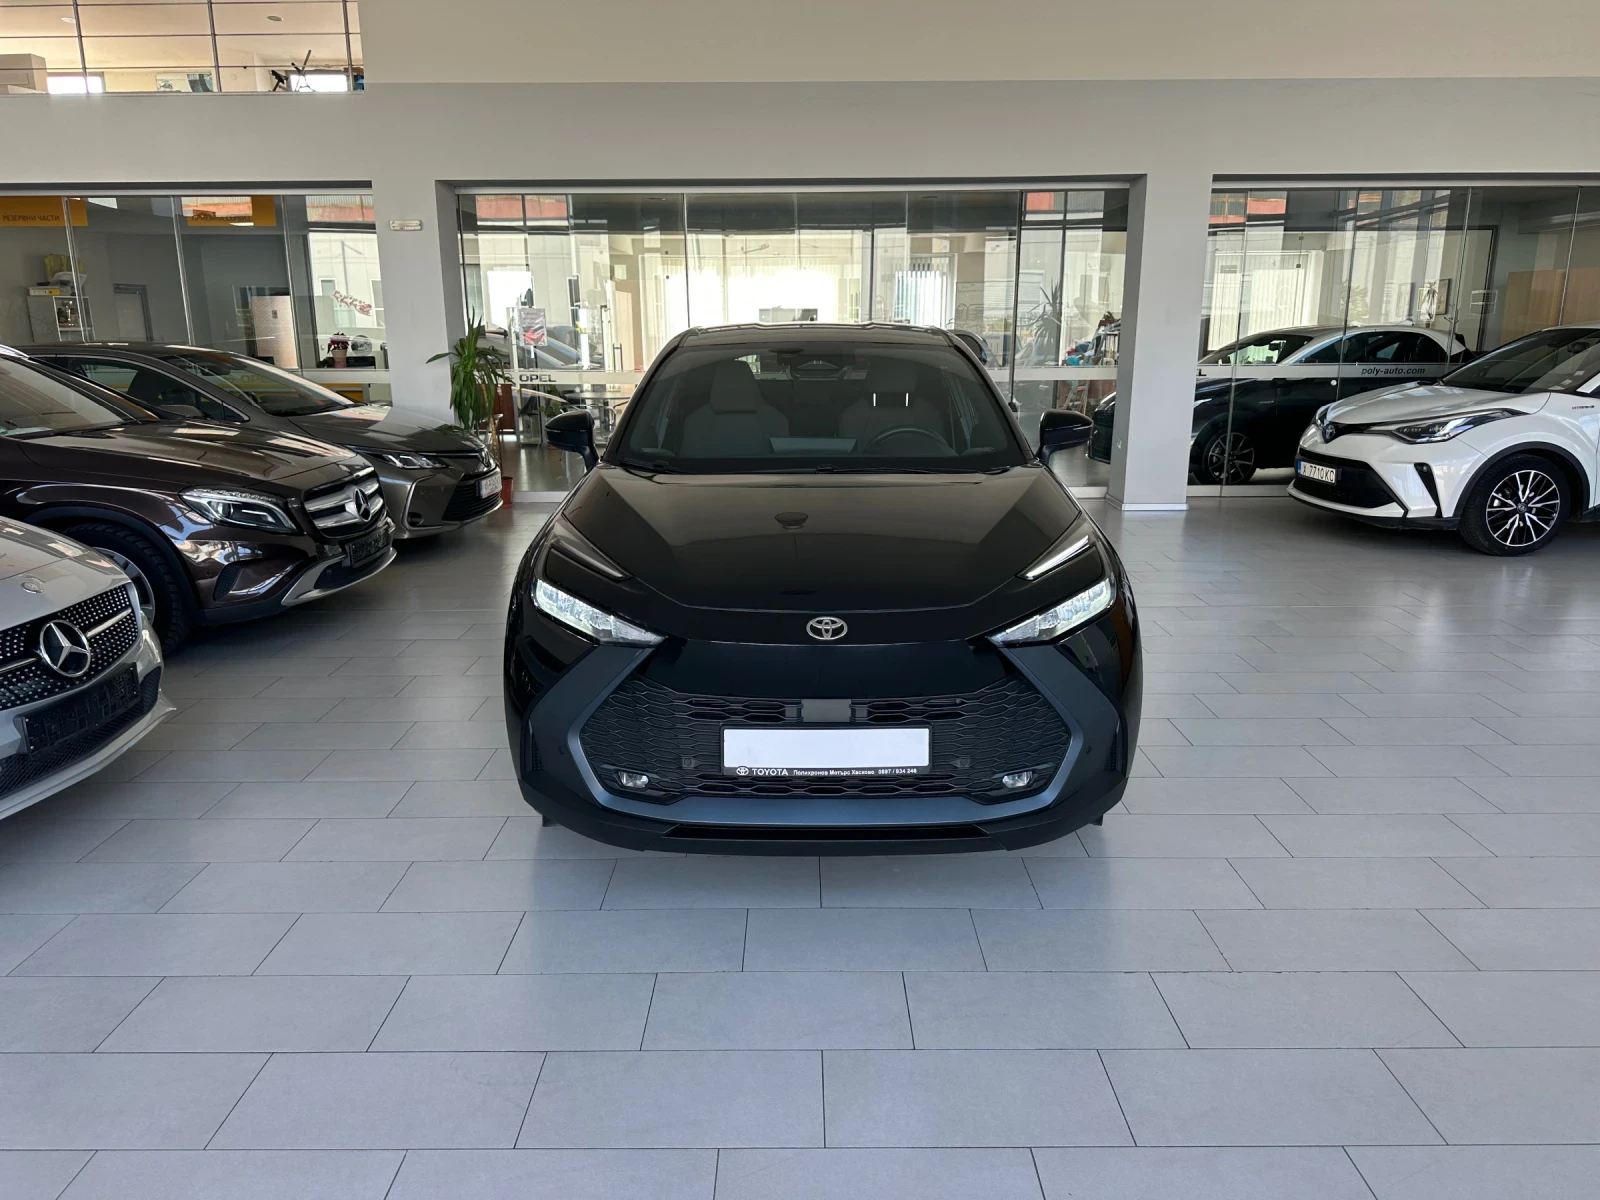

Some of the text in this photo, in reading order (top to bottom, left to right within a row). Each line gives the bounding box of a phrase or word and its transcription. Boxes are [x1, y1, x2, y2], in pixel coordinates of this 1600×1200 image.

[3, 214, 36, 222] РЕЗЕРВНИ
[1361, 367, 1425, 376] poly-auto.com
[519, 373, 557, 382] OPEL
[752, 768, 789, 776] TOYOTA
